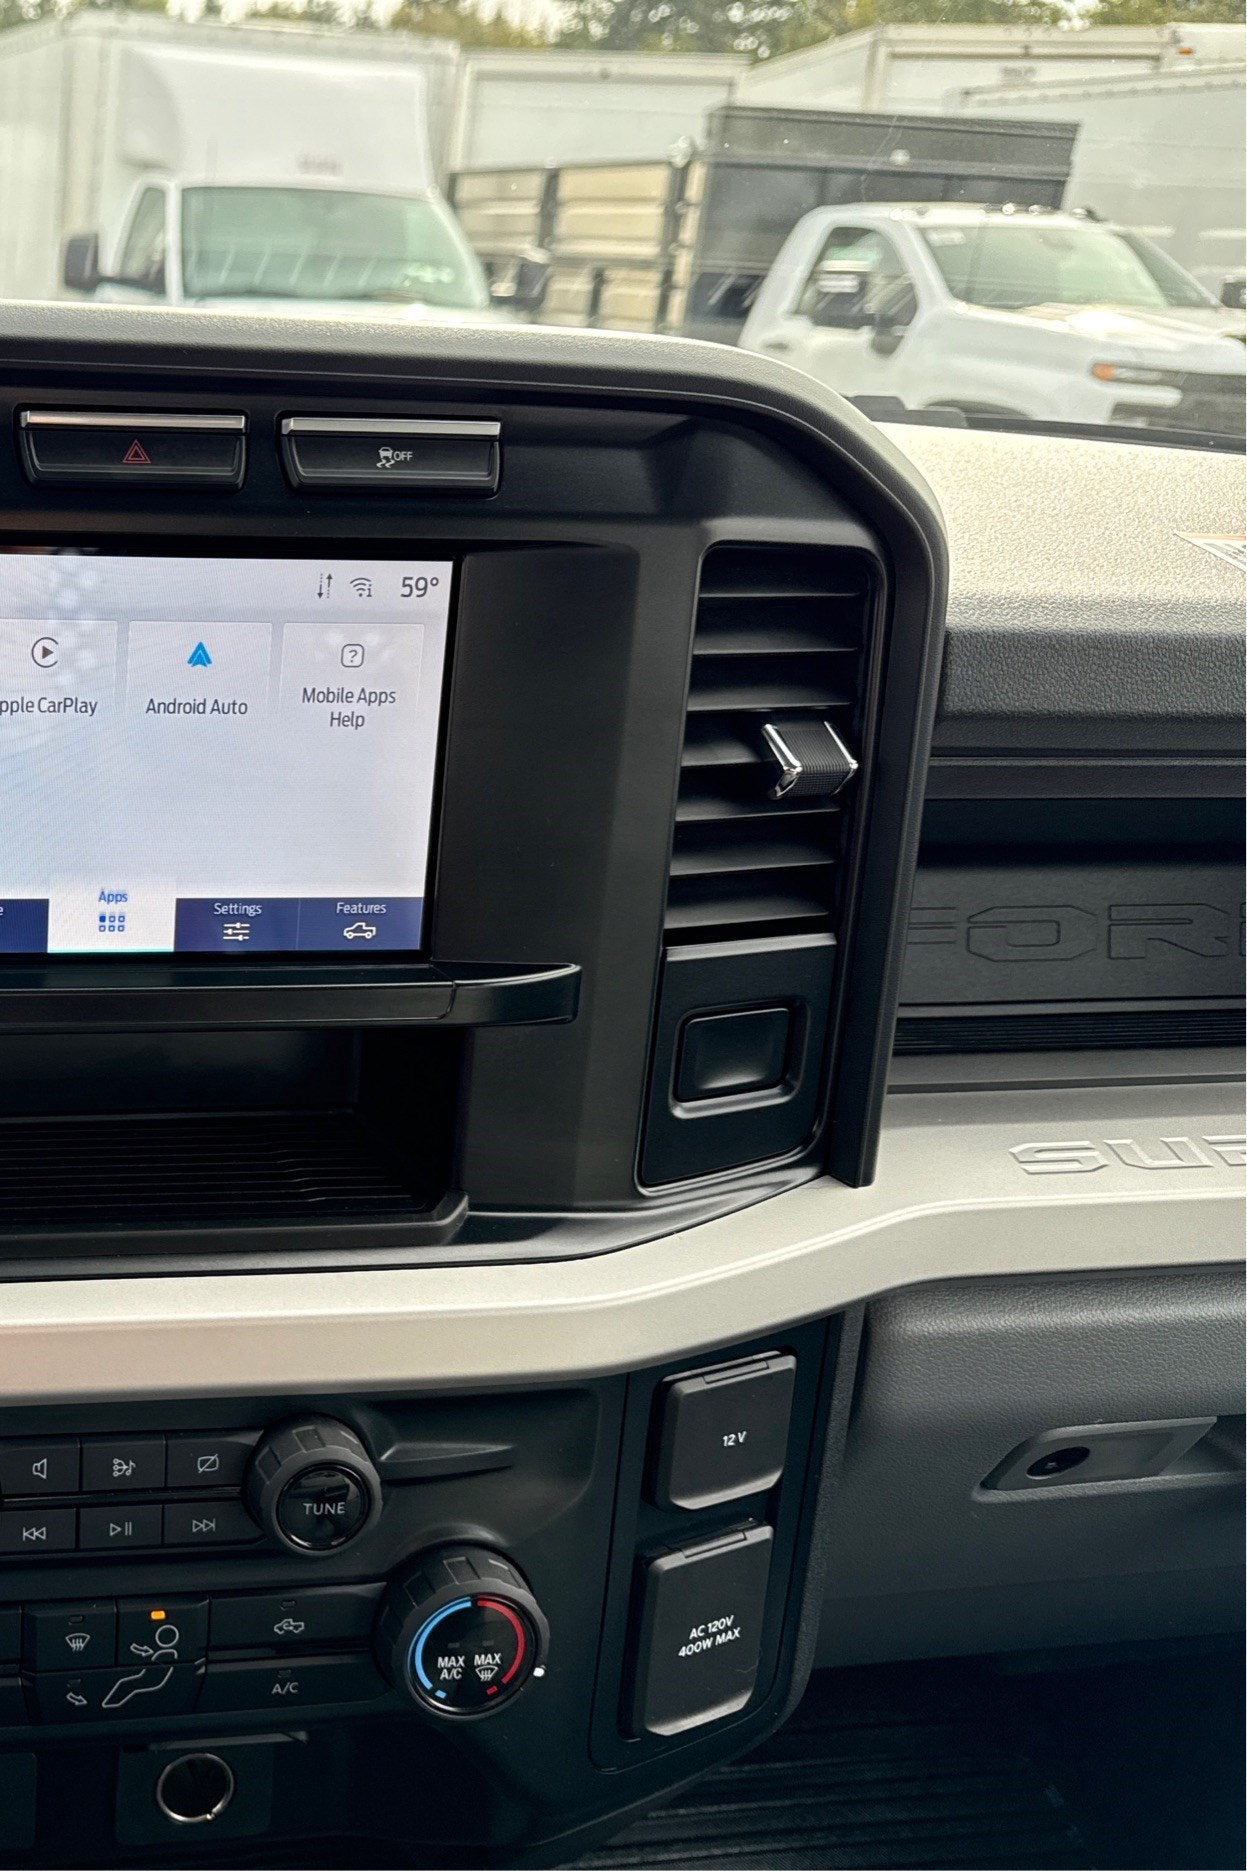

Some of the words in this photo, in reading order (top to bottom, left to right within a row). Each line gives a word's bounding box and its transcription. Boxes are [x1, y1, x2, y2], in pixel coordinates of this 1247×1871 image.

[393, 451, 414, 462] OFF
[400, 576, 441, 598] 59°
[301, 686, 354, 706] Mobile
[357, 687, 397, 709] Apps
[37, 696, 98, 716] CarPlay
[145, 698, 206, 715] Android
[209, 699, 248, 716] Auto
[329, 710, 365, 731] Help
[98, 890, 128, 904] Apps
[213, 902, 262, 917] Settings
[335, 901, 387, 915] Features
[722, 1433, 737, 1447] 12
[737, 1431, 747, 1443] V
[302, 1501, 346, 1516] TUNE
[689, 1625, 706, 1640] AC
[707, 1614, 735, 1634] 120V
[678, 1636, 713, 1658] 400W
[715, 1626, 742, 1644] MAX
[437, 1655, 466, 1669] MAX
[474, 1652, 502, 1666] MAX
[439, 1667, 463, 1681] A/C
[271, 1681, 300, 1695] A/C
